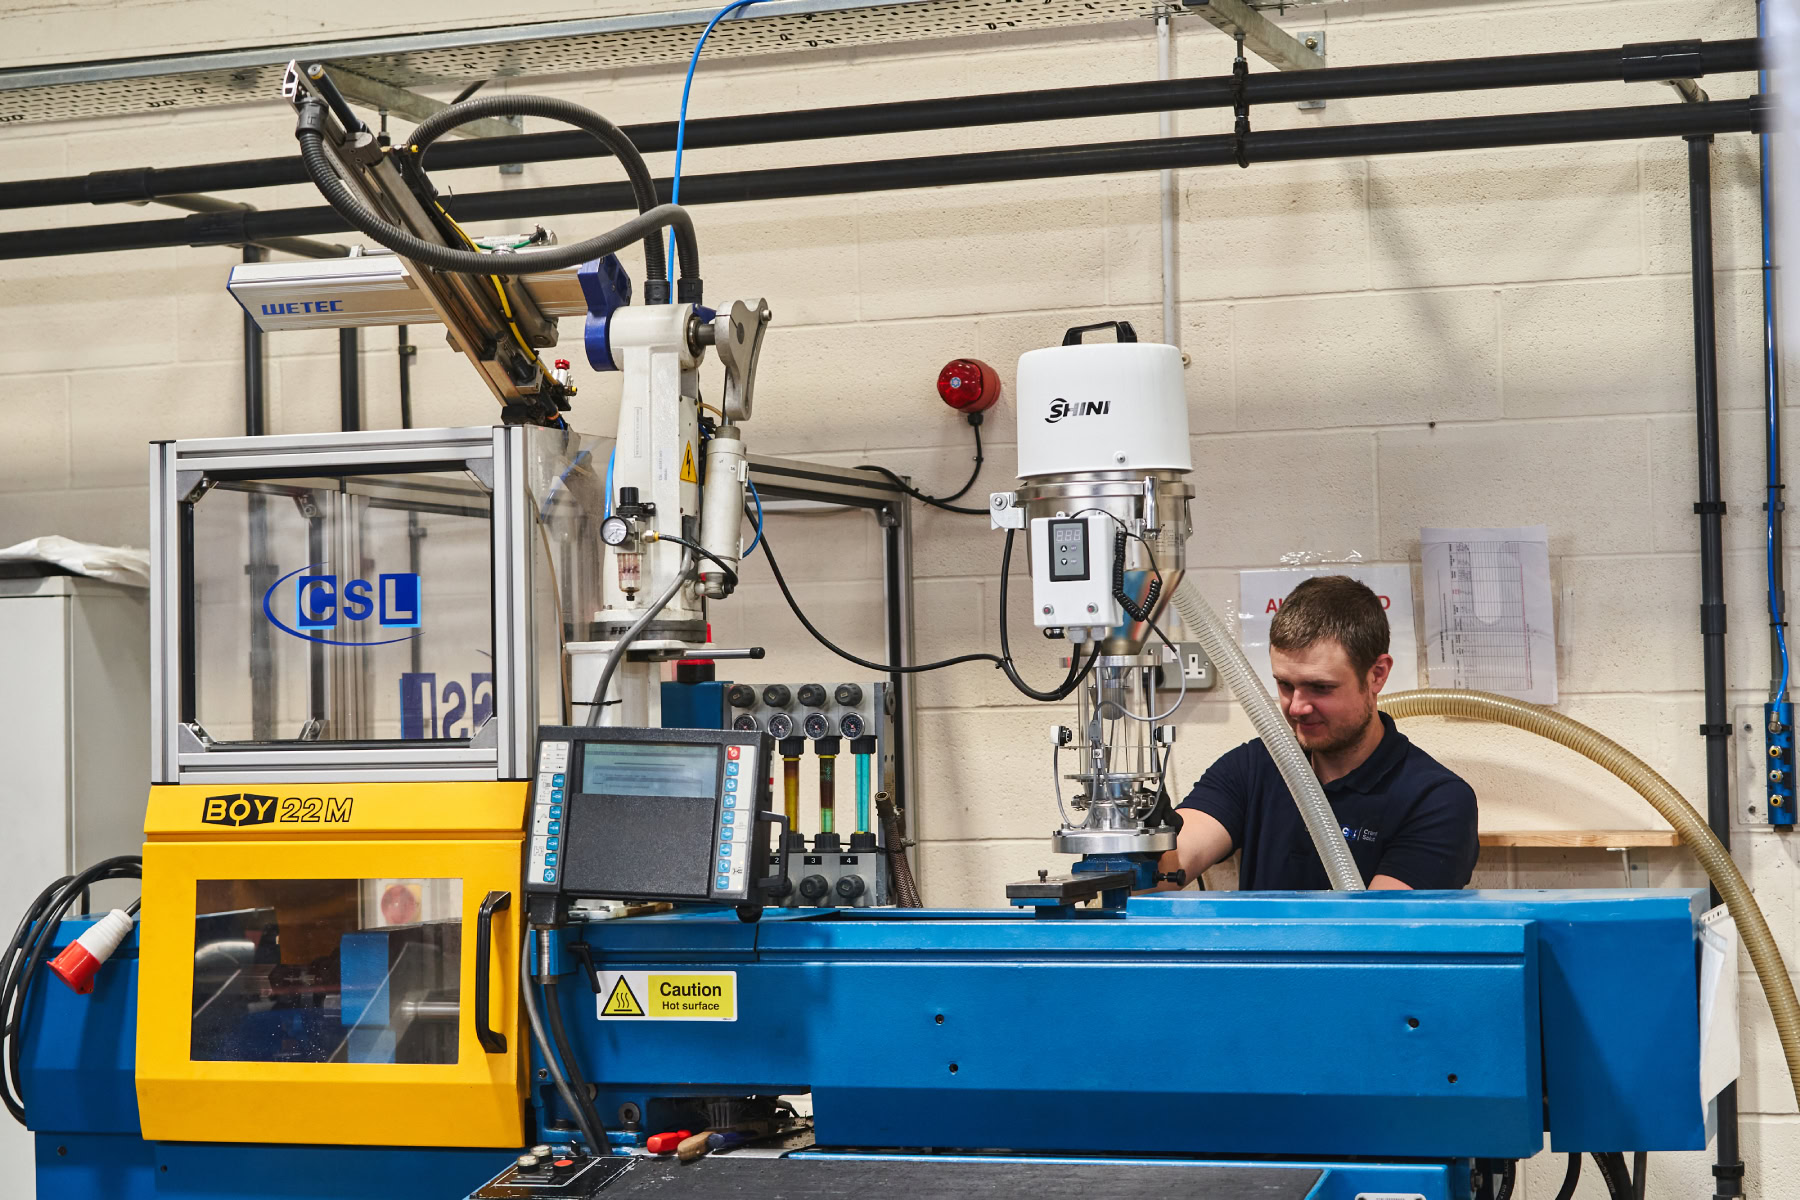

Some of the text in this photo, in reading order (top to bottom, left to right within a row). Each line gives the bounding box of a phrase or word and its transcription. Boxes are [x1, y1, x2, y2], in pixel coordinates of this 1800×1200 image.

[261, 300, 344, 315] WETEC
[1047, 399, 1111, 420] SHINI
[299, 577, 416, 624] CSL
[204, 796, 353, 824] BOY 22M
[660, 982, 722, 997] Caution
[662, 1001, 720, 1011] Hot surface
